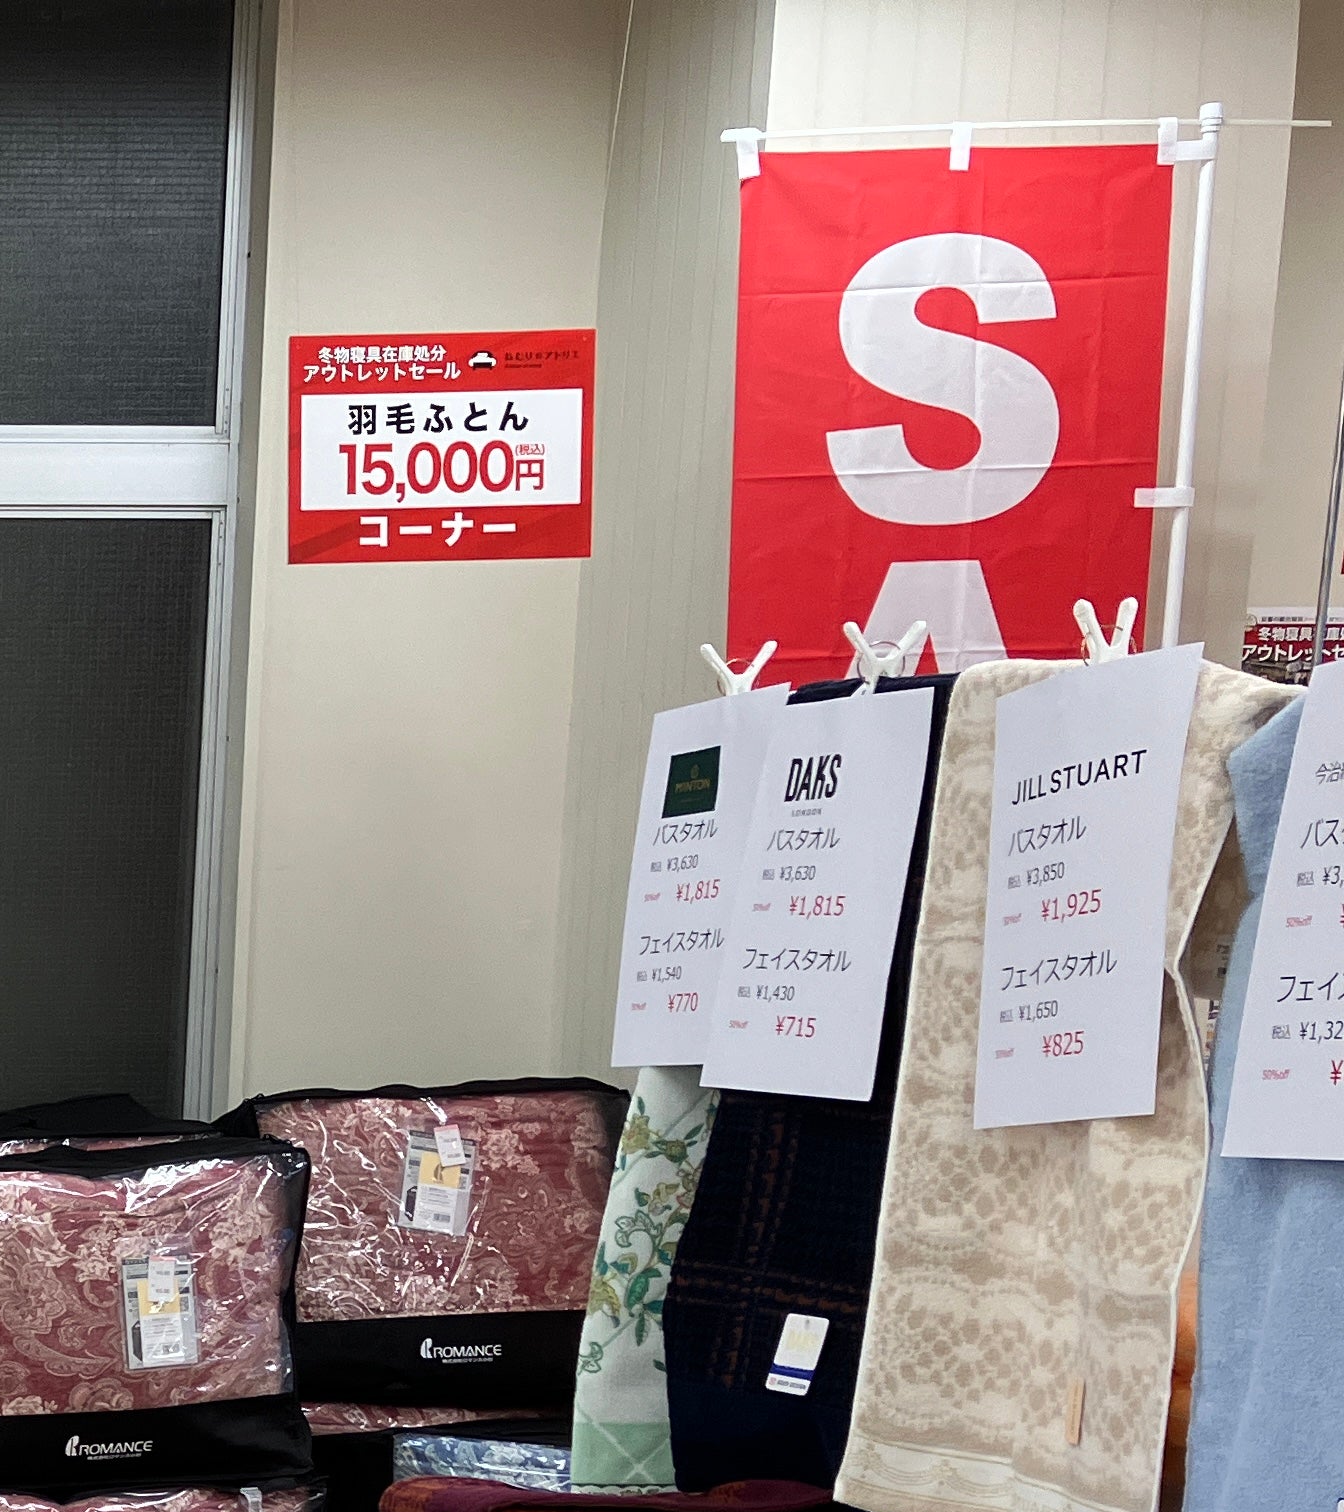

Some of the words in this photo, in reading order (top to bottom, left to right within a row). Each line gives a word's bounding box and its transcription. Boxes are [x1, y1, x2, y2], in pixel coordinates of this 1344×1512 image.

[318, 345, 447, 364] 冬物寝具在庫処分
[303, 364, 461, 383] アウトレットセール
[348, 402, 529, 435] 羽毛ふとん
[359, 512, 516, 547] コーナー
[784, 754, 842, 802] DAKS
[653, 819, 718, 846] バスタオル
[767, 827, 840, 851] バスタオル
[1007, 815, 1087, 857] バスタオル
[1300, 819, 1344, 849] バス
[676, 879, 720, 904] ¥1,815
[789, 896, 846, 920] ¥1,815
[1041, 888, 1102, 923] ¥1,925
[639, 927, 725, 956] フェイスタオル
[743, 948, 852, 972] フェイスタオル
[1001, 949, 1118, 991] フェイスタオル
[1277, 973, 1344, 1002] フェイ
[668, 992, 698, 1013] ¥770
[775, 1015, 817, 1038] ¥715
[1042, 1030, 1085, 1058] ¥825
[433, 1344, 502, 1358] ROMANCE
[78, 1440, 154, 1456] ROMANCE
